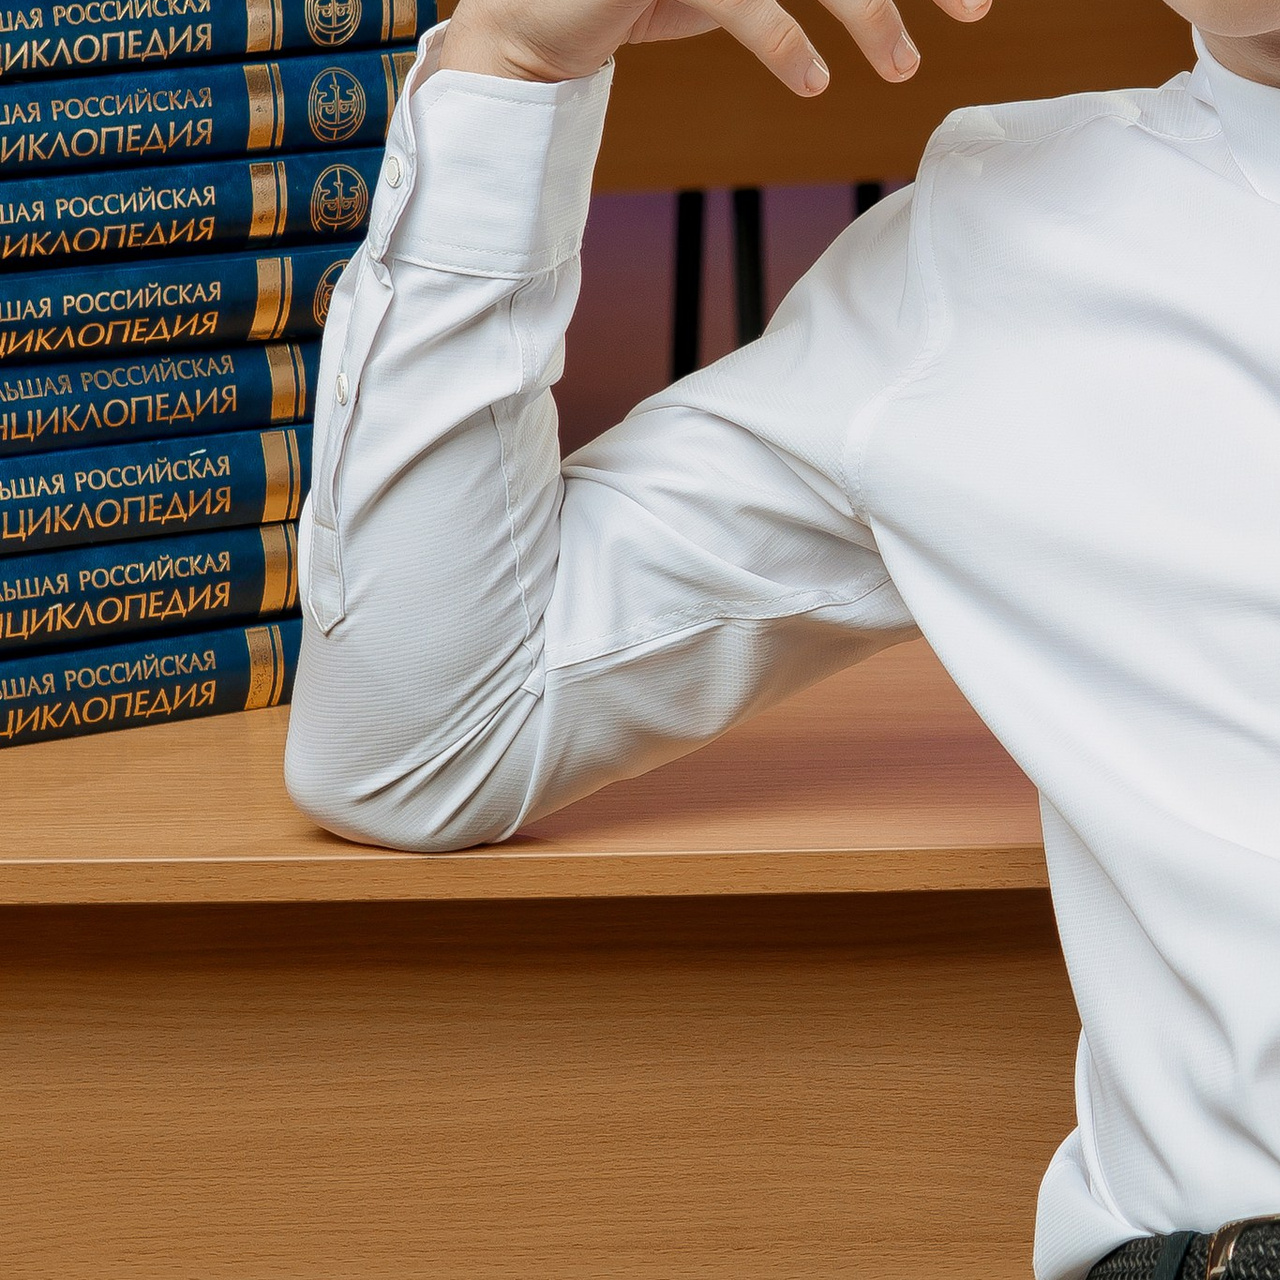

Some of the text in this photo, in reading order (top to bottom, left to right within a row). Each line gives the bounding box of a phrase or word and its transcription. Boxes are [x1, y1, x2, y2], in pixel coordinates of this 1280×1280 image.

[0, 24, 211, 75] ИКЛОПЕДИЯ
[52, 88, 212, 120] РОССИЙСКАЯ
[56, 186, 215, 219] РОССИЙСКАЯ
[0, 282, 221, 322] ШАЯ РОССИЙСКАЯ
[81, 355, 234, 391] РОССИЙСКАЯ
[0, 455, 230, 500] ЬШАЯ РОССИЙСКАЯ
[2, 486, 230, 542] ЦИКЛОПЕДИЯ
[0, 552, 230, 601] ЬШАЯ РОССИЙСКАЯ
[0, 582, 230, 640] ЦИКЛОПЕДИЯ
[0, 650, 216, 700] ШАЯ РОССИЙСКАЯ
